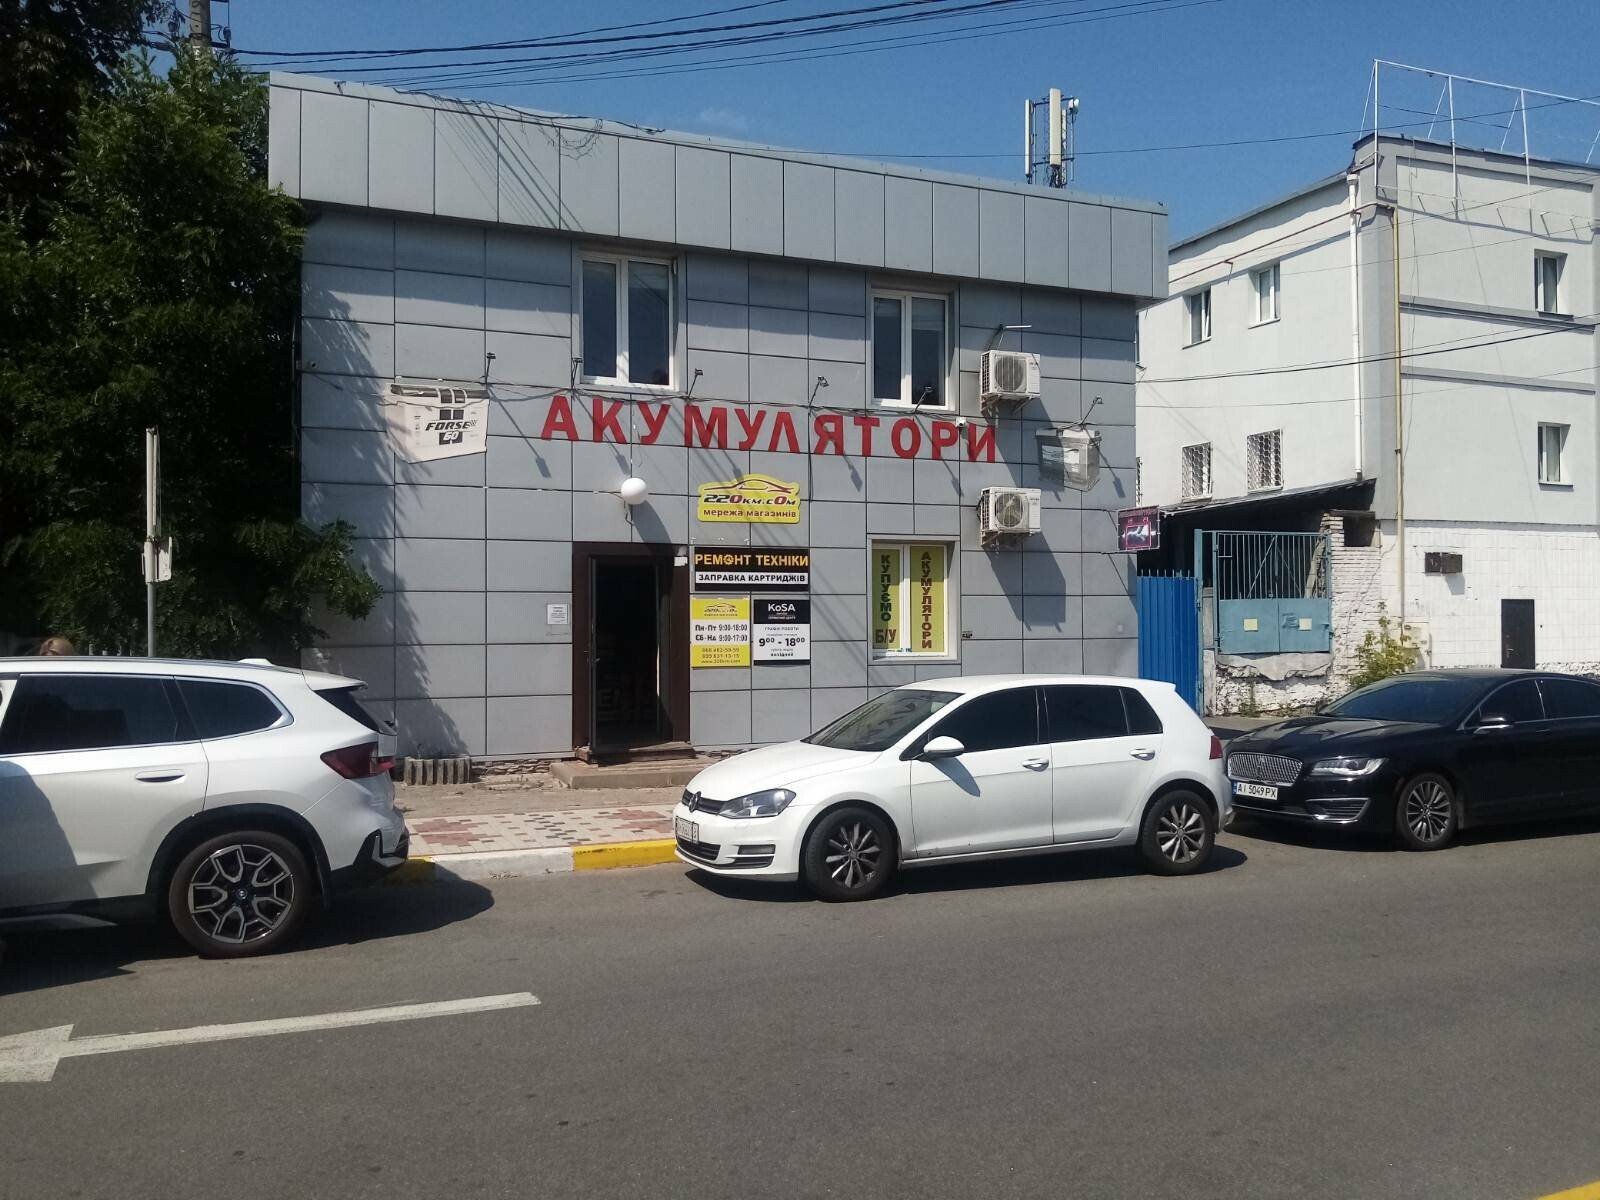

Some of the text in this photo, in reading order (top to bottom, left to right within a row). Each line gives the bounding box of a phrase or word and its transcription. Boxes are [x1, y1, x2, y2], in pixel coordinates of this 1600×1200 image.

[425, 421, 471, 431] FORSE
[540, 395, 996, 463] АКУМУЛЯТОРИ
[746, 510, 796, 518] магазинів
[695, 553, 808, 566] РЕМОНТ ТЕХНІКИ
[698, 574, 746, 582] ЗАПРАВКА
[880, 555, 892, 621] КУПУЄМО
[920, 551, 932, 648] АКУМУЛЯТОРИ
[768, 603, 796, 612] KoSA
[875, 629, 896, 643] Б/У
